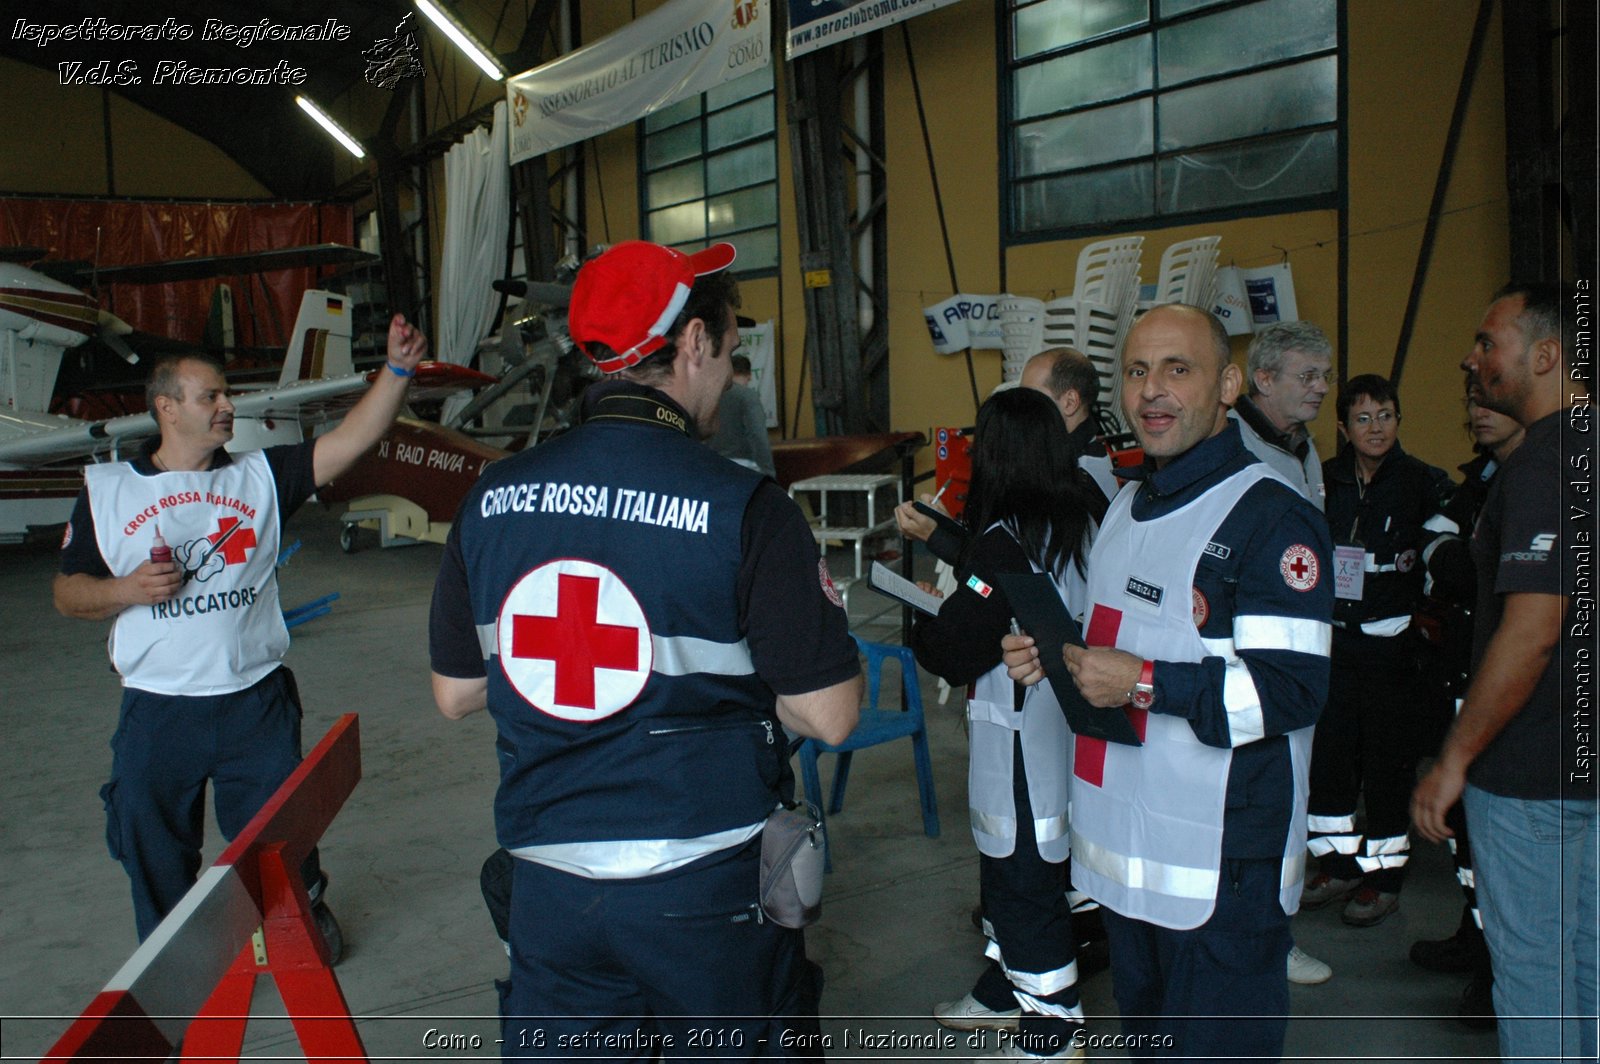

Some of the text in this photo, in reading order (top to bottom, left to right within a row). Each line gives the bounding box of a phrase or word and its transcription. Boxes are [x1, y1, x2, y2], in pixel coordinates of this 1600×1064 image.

[538, 71, 617, 120] ASSESSORATO
[620, 64, 637, 83] AL
[640, 21, 714, 74] TURISMO
[728, 39, 763, 69] COMO
[378, 440, 390, 458] XI
[396, 443, 424, 465] RAID
[427, 449, 465, 473] PAVIA
[124, 491, 257, 537] CROCE ROSSA ITALIANA
[480, 482, 709, 534] CROCE ROSSA ITALIANA
[151, 586, 258, 621] TRUCCATORE
